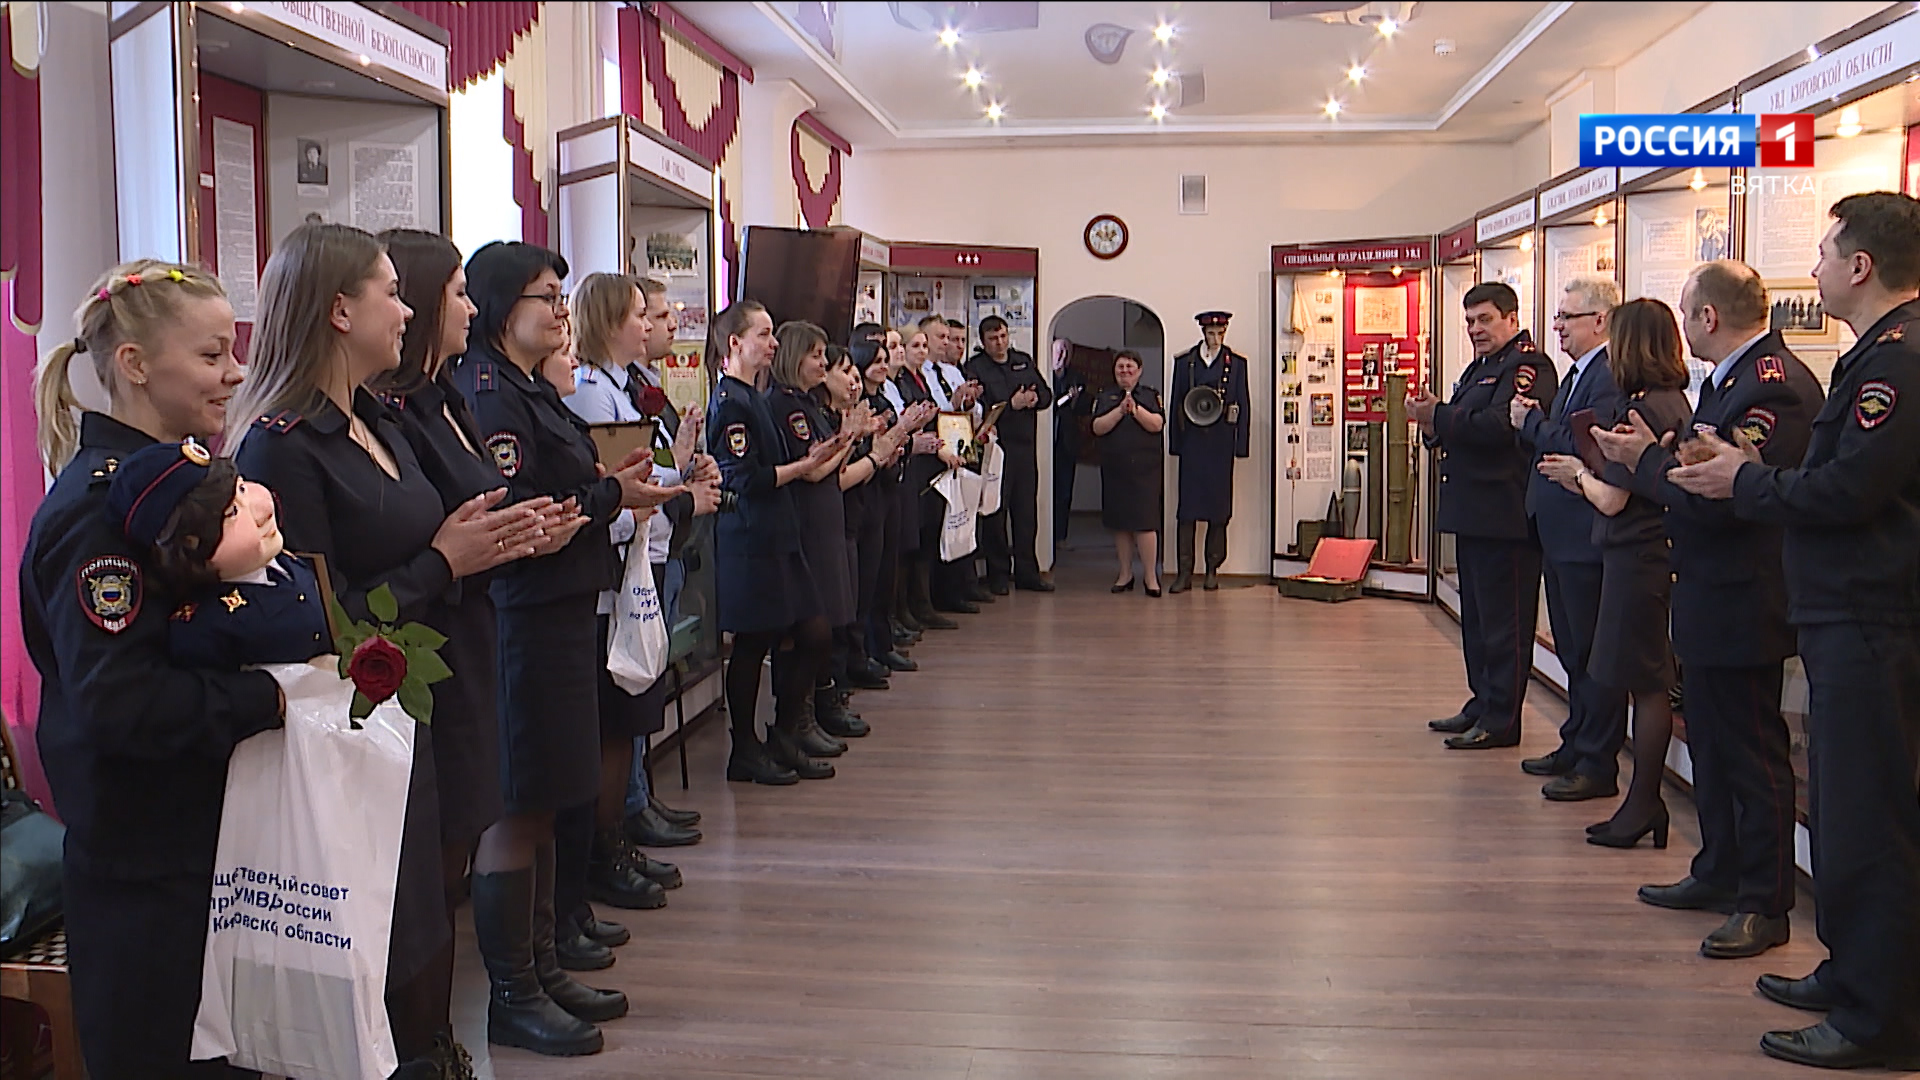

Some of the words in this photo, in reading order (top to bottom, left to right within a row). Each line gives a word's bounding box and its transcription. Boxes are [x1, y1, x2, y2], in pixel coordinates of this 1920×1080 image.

[371, 29, 437, 77] БЕЗОПАСНОСТИ
[1790, 59, 1842, 104] КИРОВСКОЙ
[1846, 41, 1893, 82] ОБЛАСТИ
[81, 558, 138, 578] ПОЛИЦИЯ
[300, 882, 350, 901] совет
[284, 923, 352, 950] области
